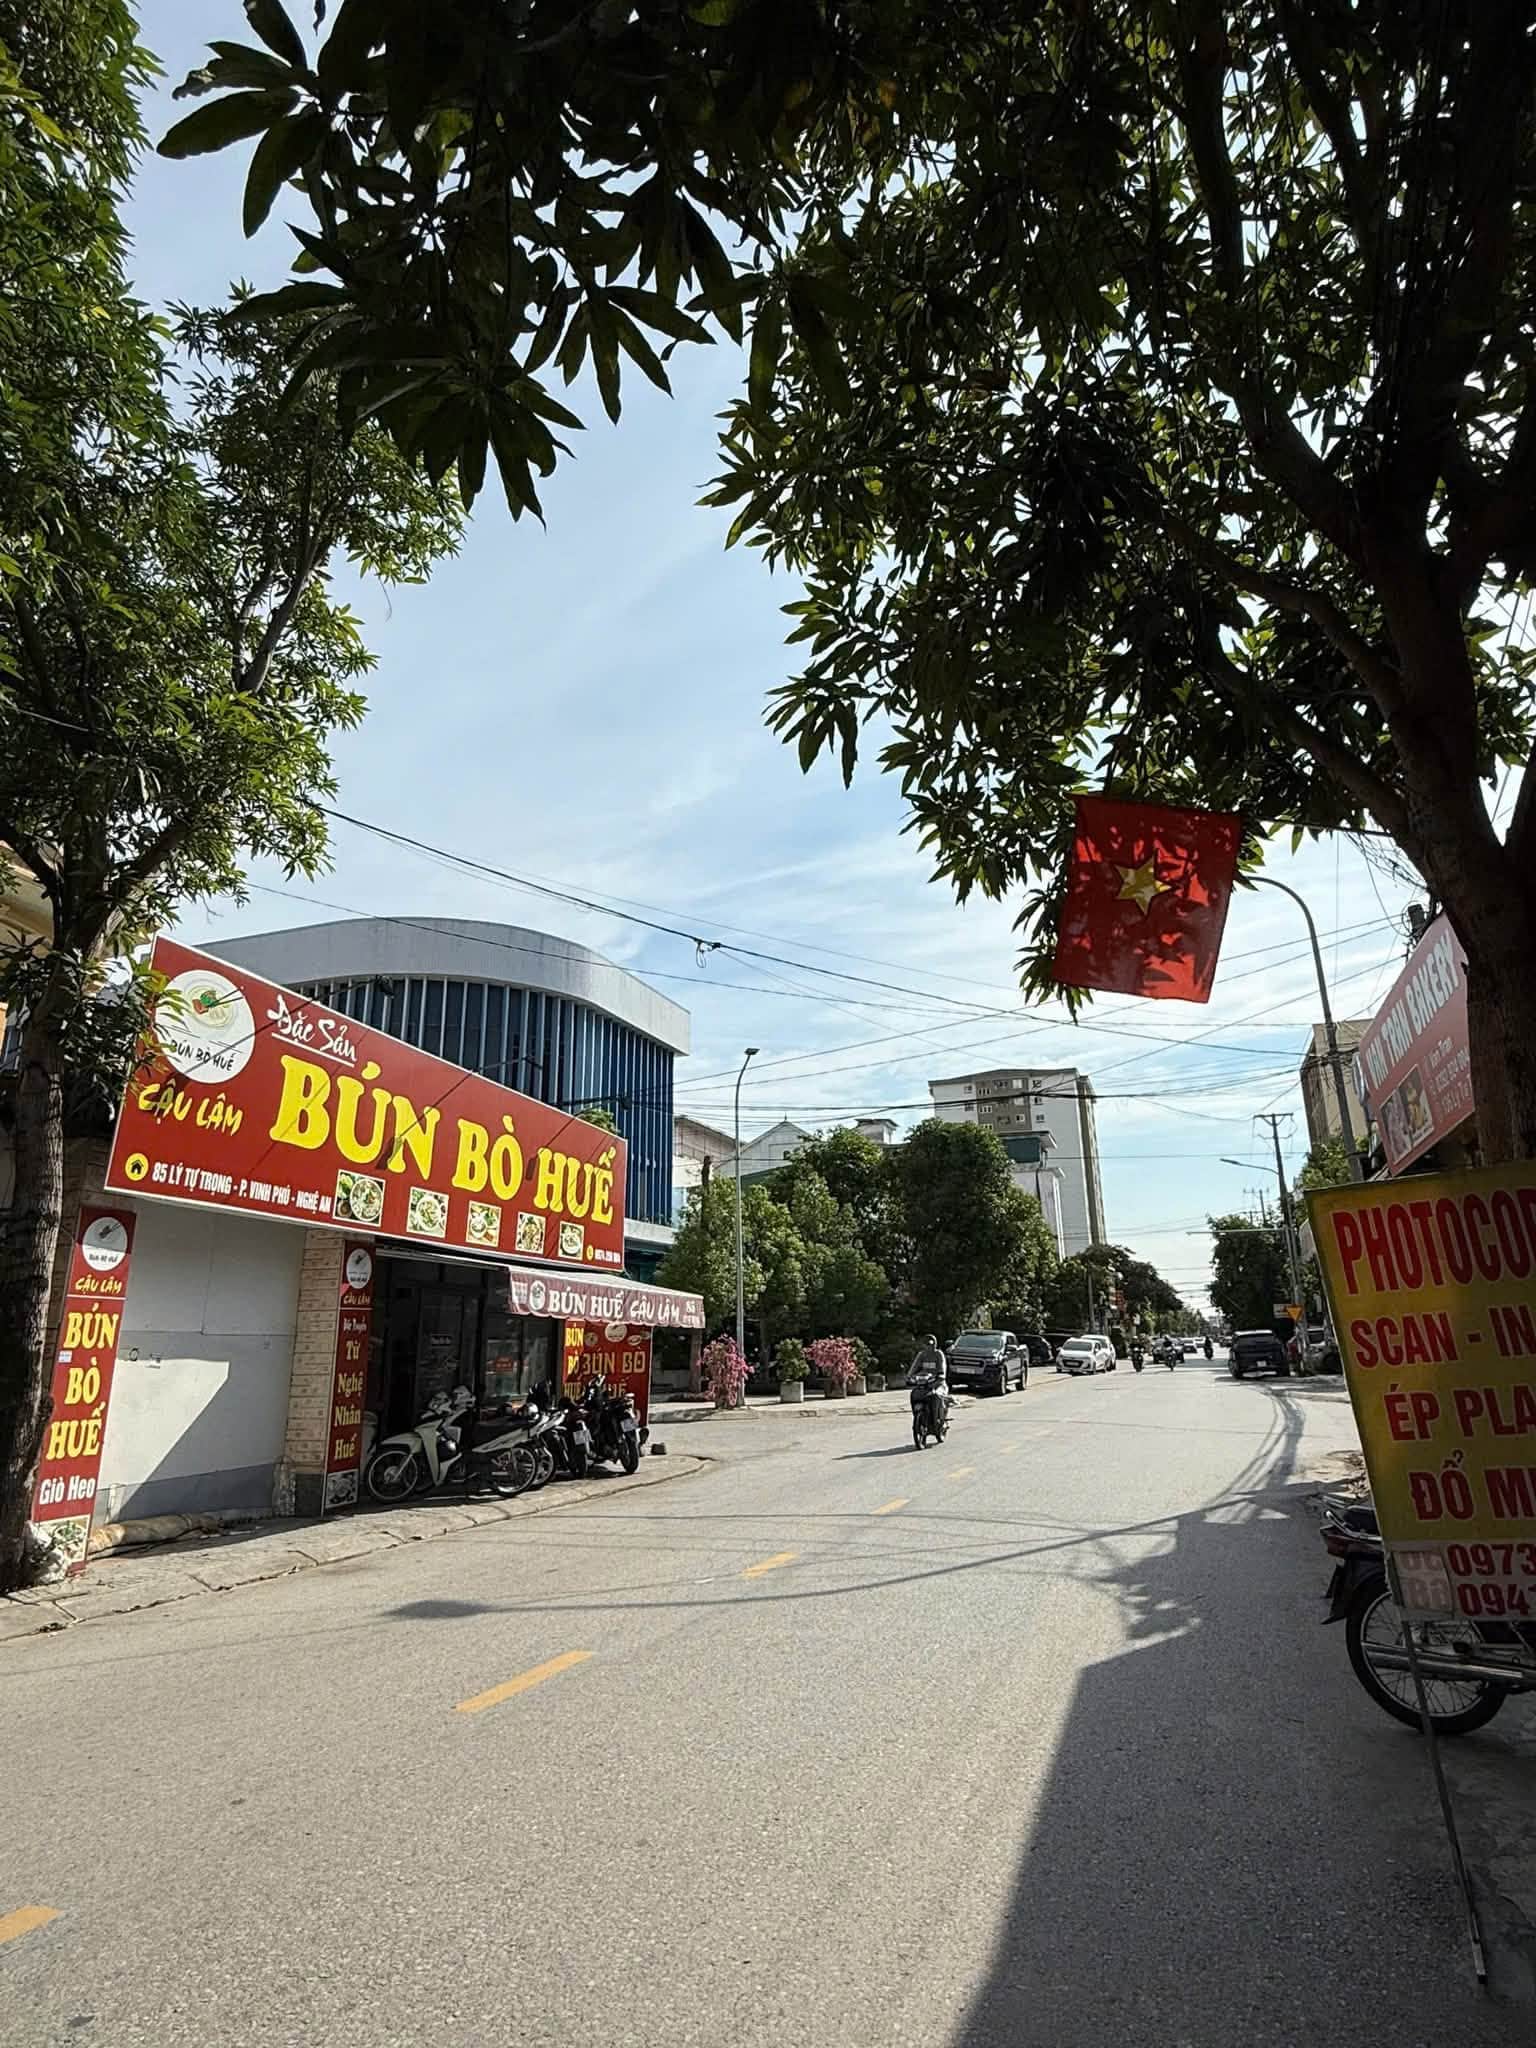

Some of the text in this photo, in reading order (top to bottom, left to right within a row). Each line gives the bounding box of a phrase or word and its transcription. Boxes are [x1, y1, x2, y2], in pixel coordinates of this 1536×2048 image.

[1405, 928, 1460, 1037] BAKERY
[267, 994, 358, 1062] Đặc Sản
[196, 1047, 211, 1064] BÒ
[213, 1053, 236, 1072] HUẾ
[138, 1078, 243, 1137] CẬU LÂM
[269, 1054, 617, 1225] BÚN BÒ HUẾ
[152, 1162, 168, 1182] 85
[168, 1162, 183, 1186] LÝ
[184, 1168, 199, 1192] TỰ
[200, 1172, 232, 1196] TRỌNG
[239, 1179, 247, 1197] P.
[249, 1180, 272, 1202] VINH
[296, 1190, 319, 1214] NGHỆ
[319, 1195, 332, 1214] AN
[75, 1274, 122, 1295] CẬU LÂM
[548, 1286, 586, 1315] BÚN
[589, 1290, 624, 1319] HUẾ
[63, 1302, 119, 1350] BÚN
[565, 1323, 584, 1346] BÚN
[1350, 1311, 1458, 1370] SCAN
[64, 1356, 101, 1405] BÒ
[568, 1350, 579, 1375] BÒ
[622, 1346, 646, 1374] BÒ
[337, 1371, 364, 1398] Nghệ
[45, 1401, 106, 1461] HUẾ
[334, 1404, 361, 1427] Nhân
[1383, 1383, 1536, 1442] ÉP PLA
[334, 1432, 358, 1461] Huế
[39, 1475, 96, 1505] Giò Heo
[1408, 1449, 1536, 1523] ĐỔ M
[1447, 1543, 1536, 1577] 0973
